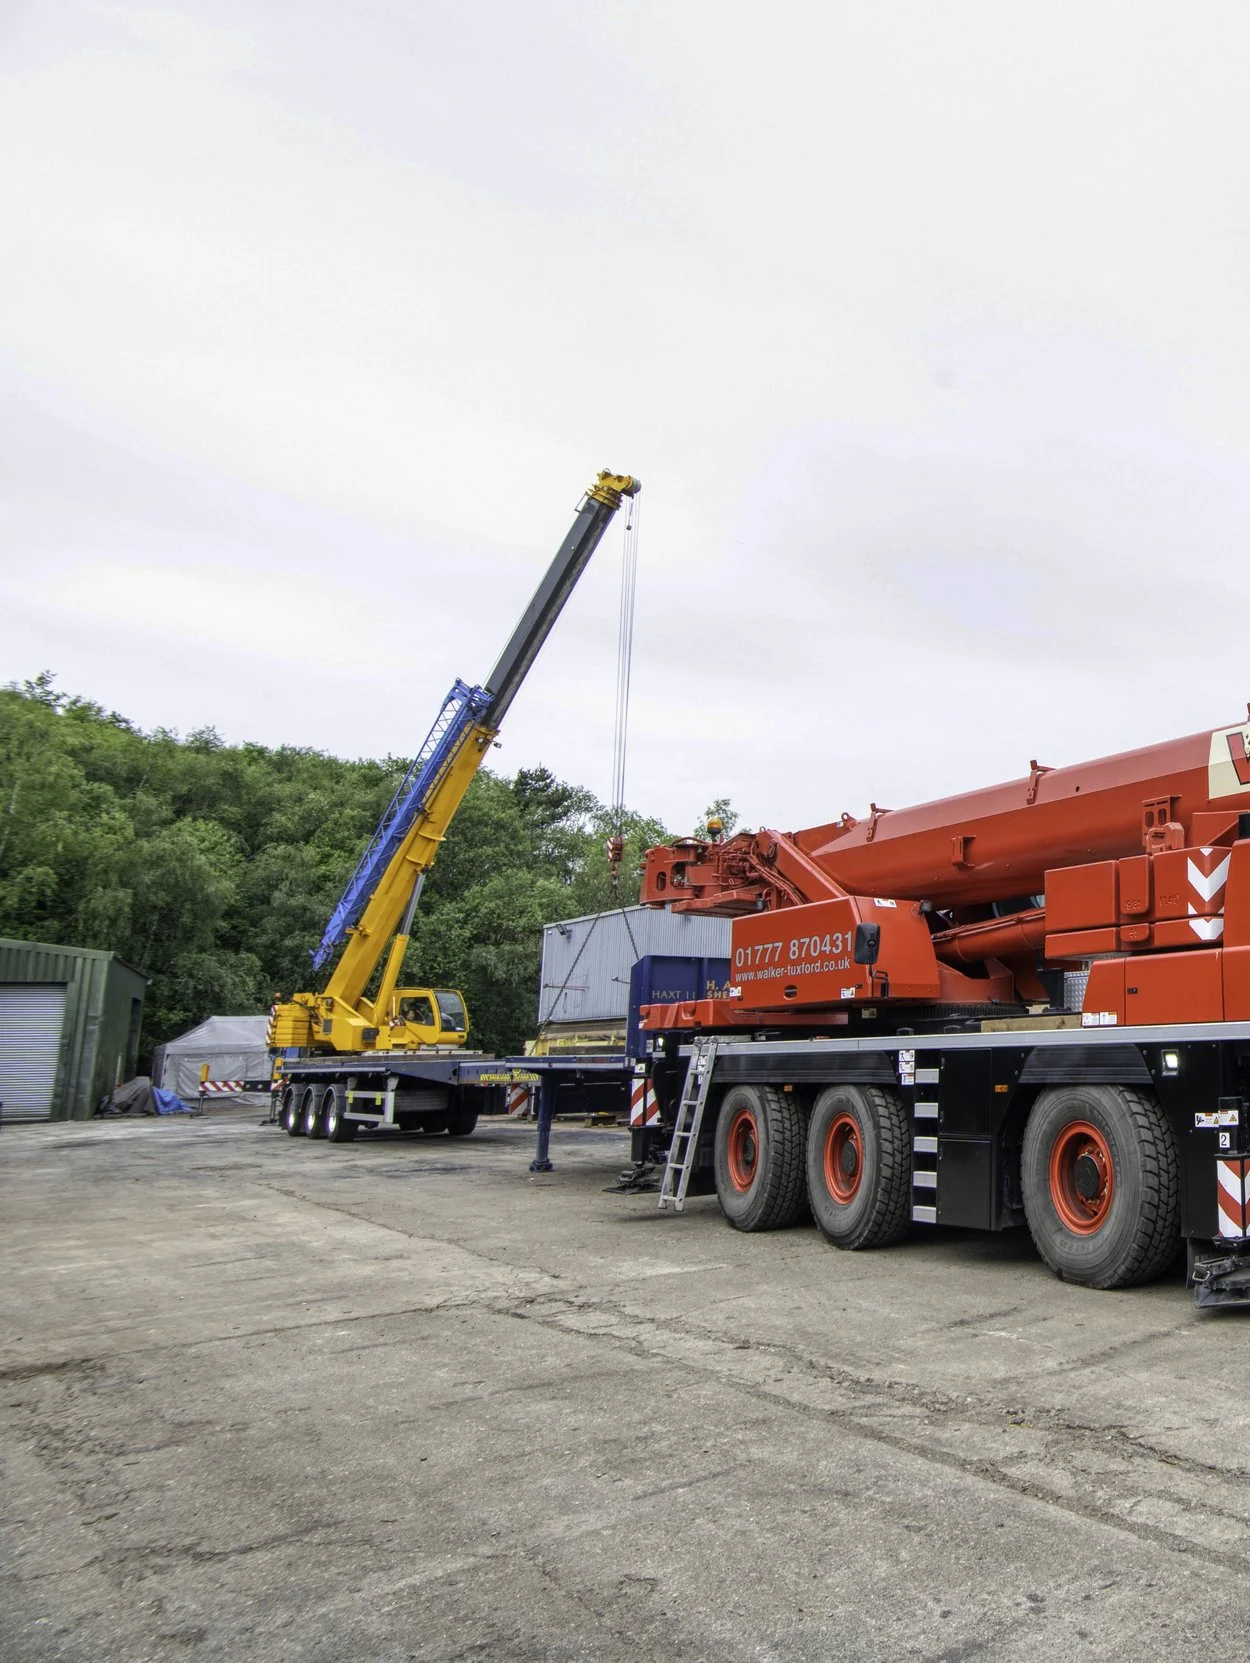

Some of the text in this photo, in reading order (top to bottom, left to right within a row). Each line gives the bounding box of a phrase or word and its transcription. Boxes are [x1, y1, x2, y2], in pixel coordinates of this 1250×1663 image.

[735, 930, 852, 967] 01777 870431
[735, 956, 851, 982] www.walker-tuxford.co.uk
[652, 990, 681, 999] HAXT
[707, 990, 729, 999] SHE
[1220, 1134, 1228, 1146] 2
